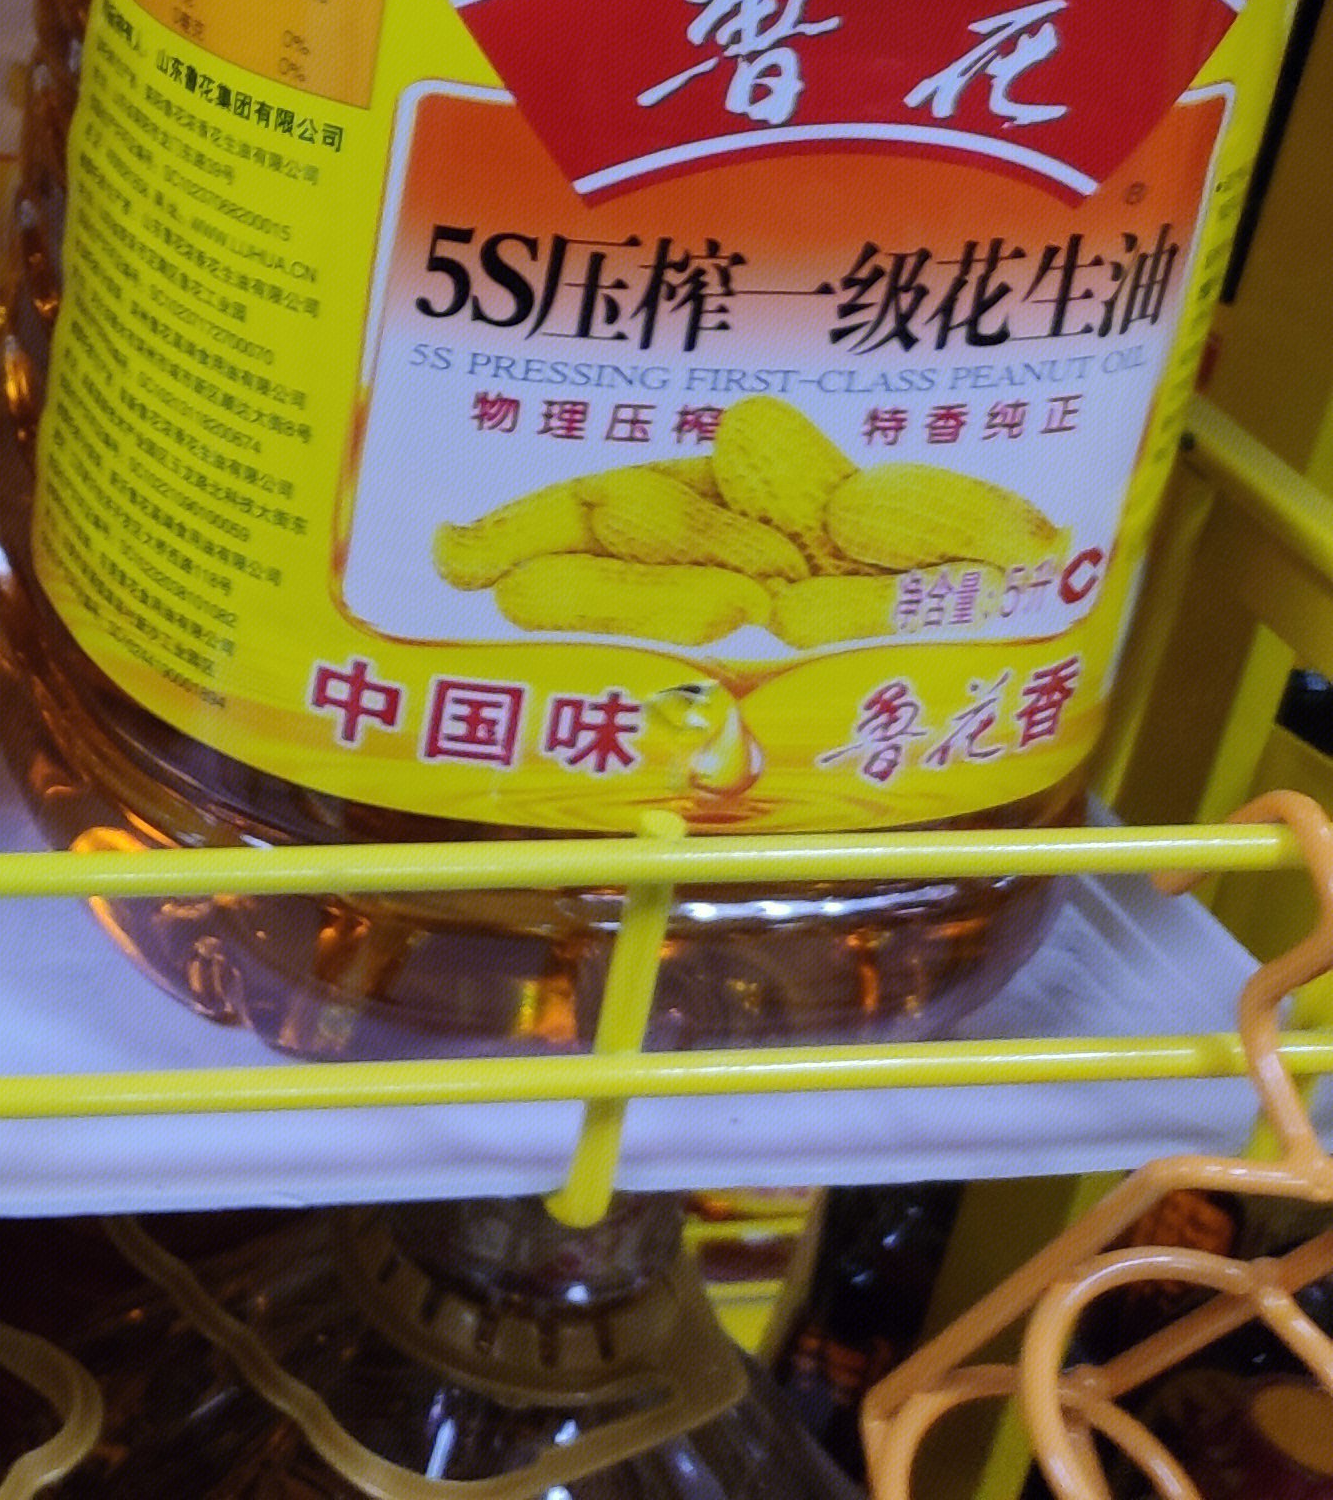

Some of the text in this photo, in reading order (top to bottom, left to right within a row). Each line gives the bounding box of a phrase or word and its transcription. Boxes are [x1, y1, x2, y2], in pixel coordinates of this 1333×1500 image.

[415, 222, 1183, 354] 5S压榨一级花生油
[409, 345, 452, 373] 5S
[468, 351, 670, 392] PRESSING
[684, 367, 939, 396] FIRST-CLASS
[949, 355, 1091, 390] PEANUT
[471, 391, 1085, 445] 物理压榨 特香纯正
[310, 658, 651, 775] 中国味
[818, 656, 1085, 782] 鲁花香
